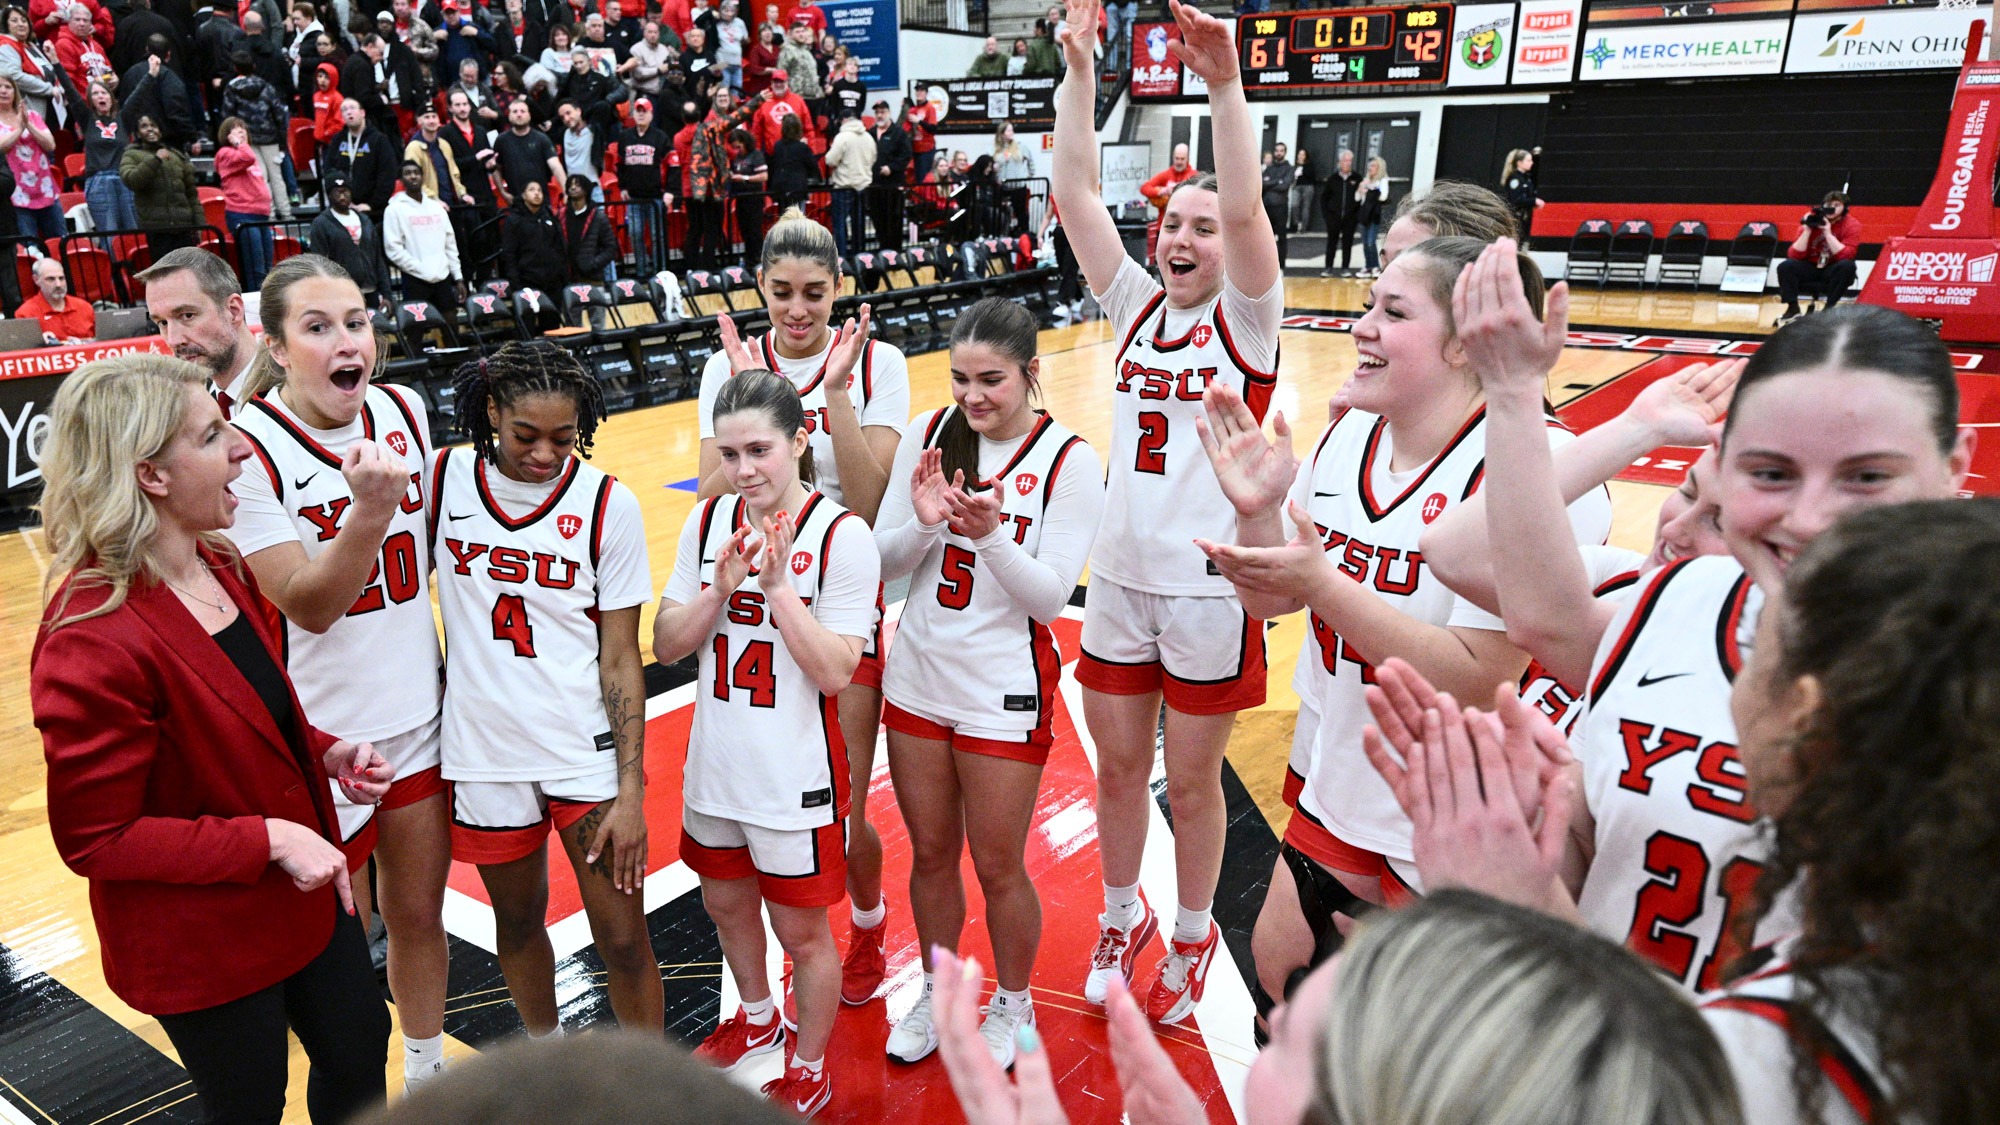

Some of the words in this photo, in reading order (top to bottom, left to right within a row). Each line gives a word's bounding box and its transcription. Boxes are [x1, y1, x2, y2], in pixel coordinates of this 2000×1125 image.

[1255, 19, 1277, 35] YSU
[1406, 11, 1438, 27] UMES
[1530, 13, 1568, 28] bryant
[1314, 16, 1369, 48] 0.0
[1250, 38, 1286, 69] 61
[1404, 30, 1442, 62] 42
[1525, 47, 1564, 62] bryant
[1843, 39, 1903, 56] PENN
[1311, 62, 1347, 75] PERIOD
[1349, 57, 1365, 80] 4
[1388, 66, 1420, 78] BONUS
[1879, 59, 1914, 67] GROUP
[1259, 72, 1290, 83] BONUS
[1963, 109, 1978, 135] REAL
[1972, 99, 1990, 136] ESTATE
[1890, 252, 1967, 266] WINDOW
[1885, 264, 1964, 282] DEPOT
[1894, 286, 1939, 295] WINDOWS
[1946, 287, 1978, 297] DOORS
[1896, 295, 1926, 304] SIDING
[1934, 296, 1972, 305] GUTTERS
[1116, 358, 1218, 402] YSU
[1135, 411, 1169, 475] 2
[298, 471, 423, 543] YU
[444, 537, 581, 590] YSU
[936, 543, 977, 612] 5
[492, 592, 538, 659] 4
[713, 633, 777, 709] 14
[1618, 717, 1758, 826] YS
